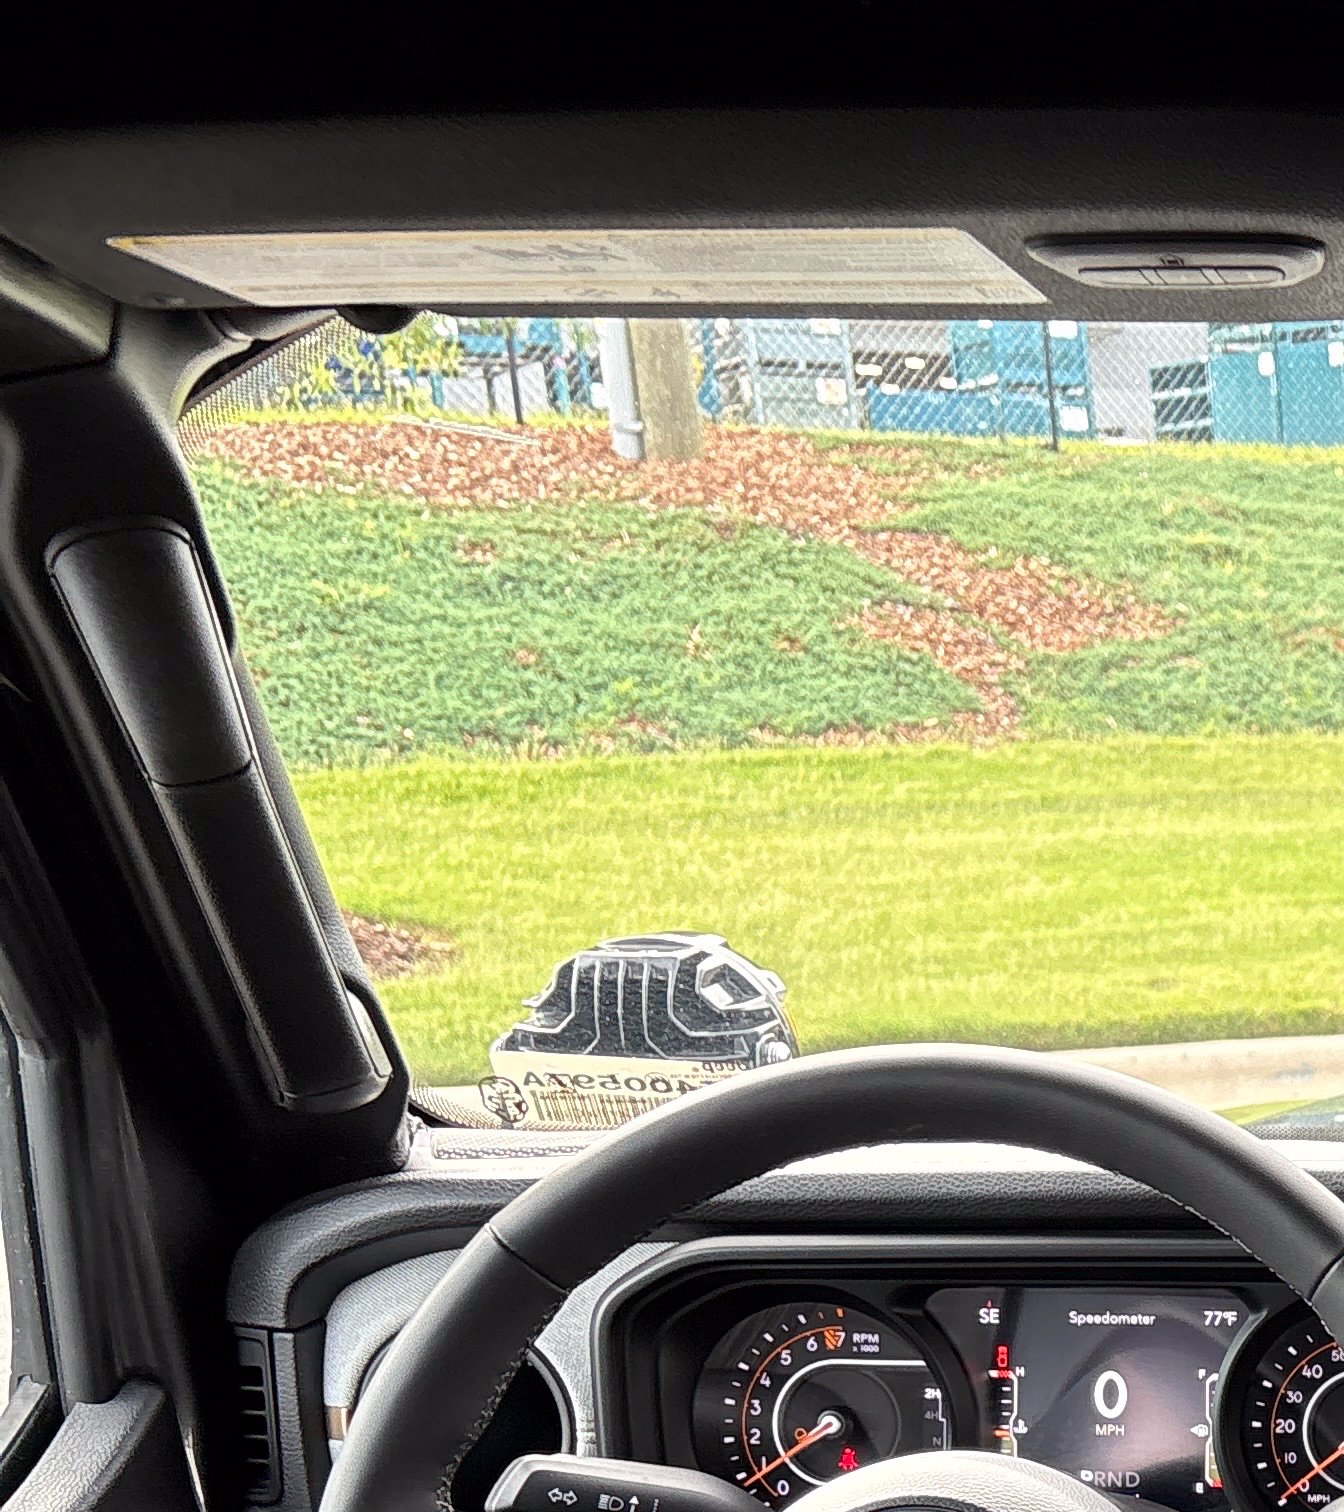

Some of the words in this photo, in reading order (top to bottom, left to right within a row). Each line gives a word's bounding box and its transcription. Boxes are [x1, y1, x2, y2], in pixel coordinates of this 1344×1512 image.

[979, 1308, 1000, 1324] SE
[1068, 1310, 1156, 1328] Speedometer
[1204, 1310, 1238, 1327] 77°F
[806, 1336, 818, 1352] 6
[852, 1332, 879, 1344] RPM
[780, 1349, 791, 1366] 5
[1302, 1363, 1323, 1379] 40
[759, 1372, 771, 1388] 4
[924, 1388, 940, 1399] 2H
[1093, 1369, 1128, 1419] 0
[1285, 1389, 1303, 1404] 30
[750, 1399, 761, 1416] 3
[1096, 1422, 1125, 1436] MPH
[1275, 1419, 1296, 1434] 20
[749, 1428, 761, 1444] 2
[1284, 1451, 1297, 1464] 10
[777, 1479, 789, 1496] 0
[1307, 1493, 1331, 1505] MPH
